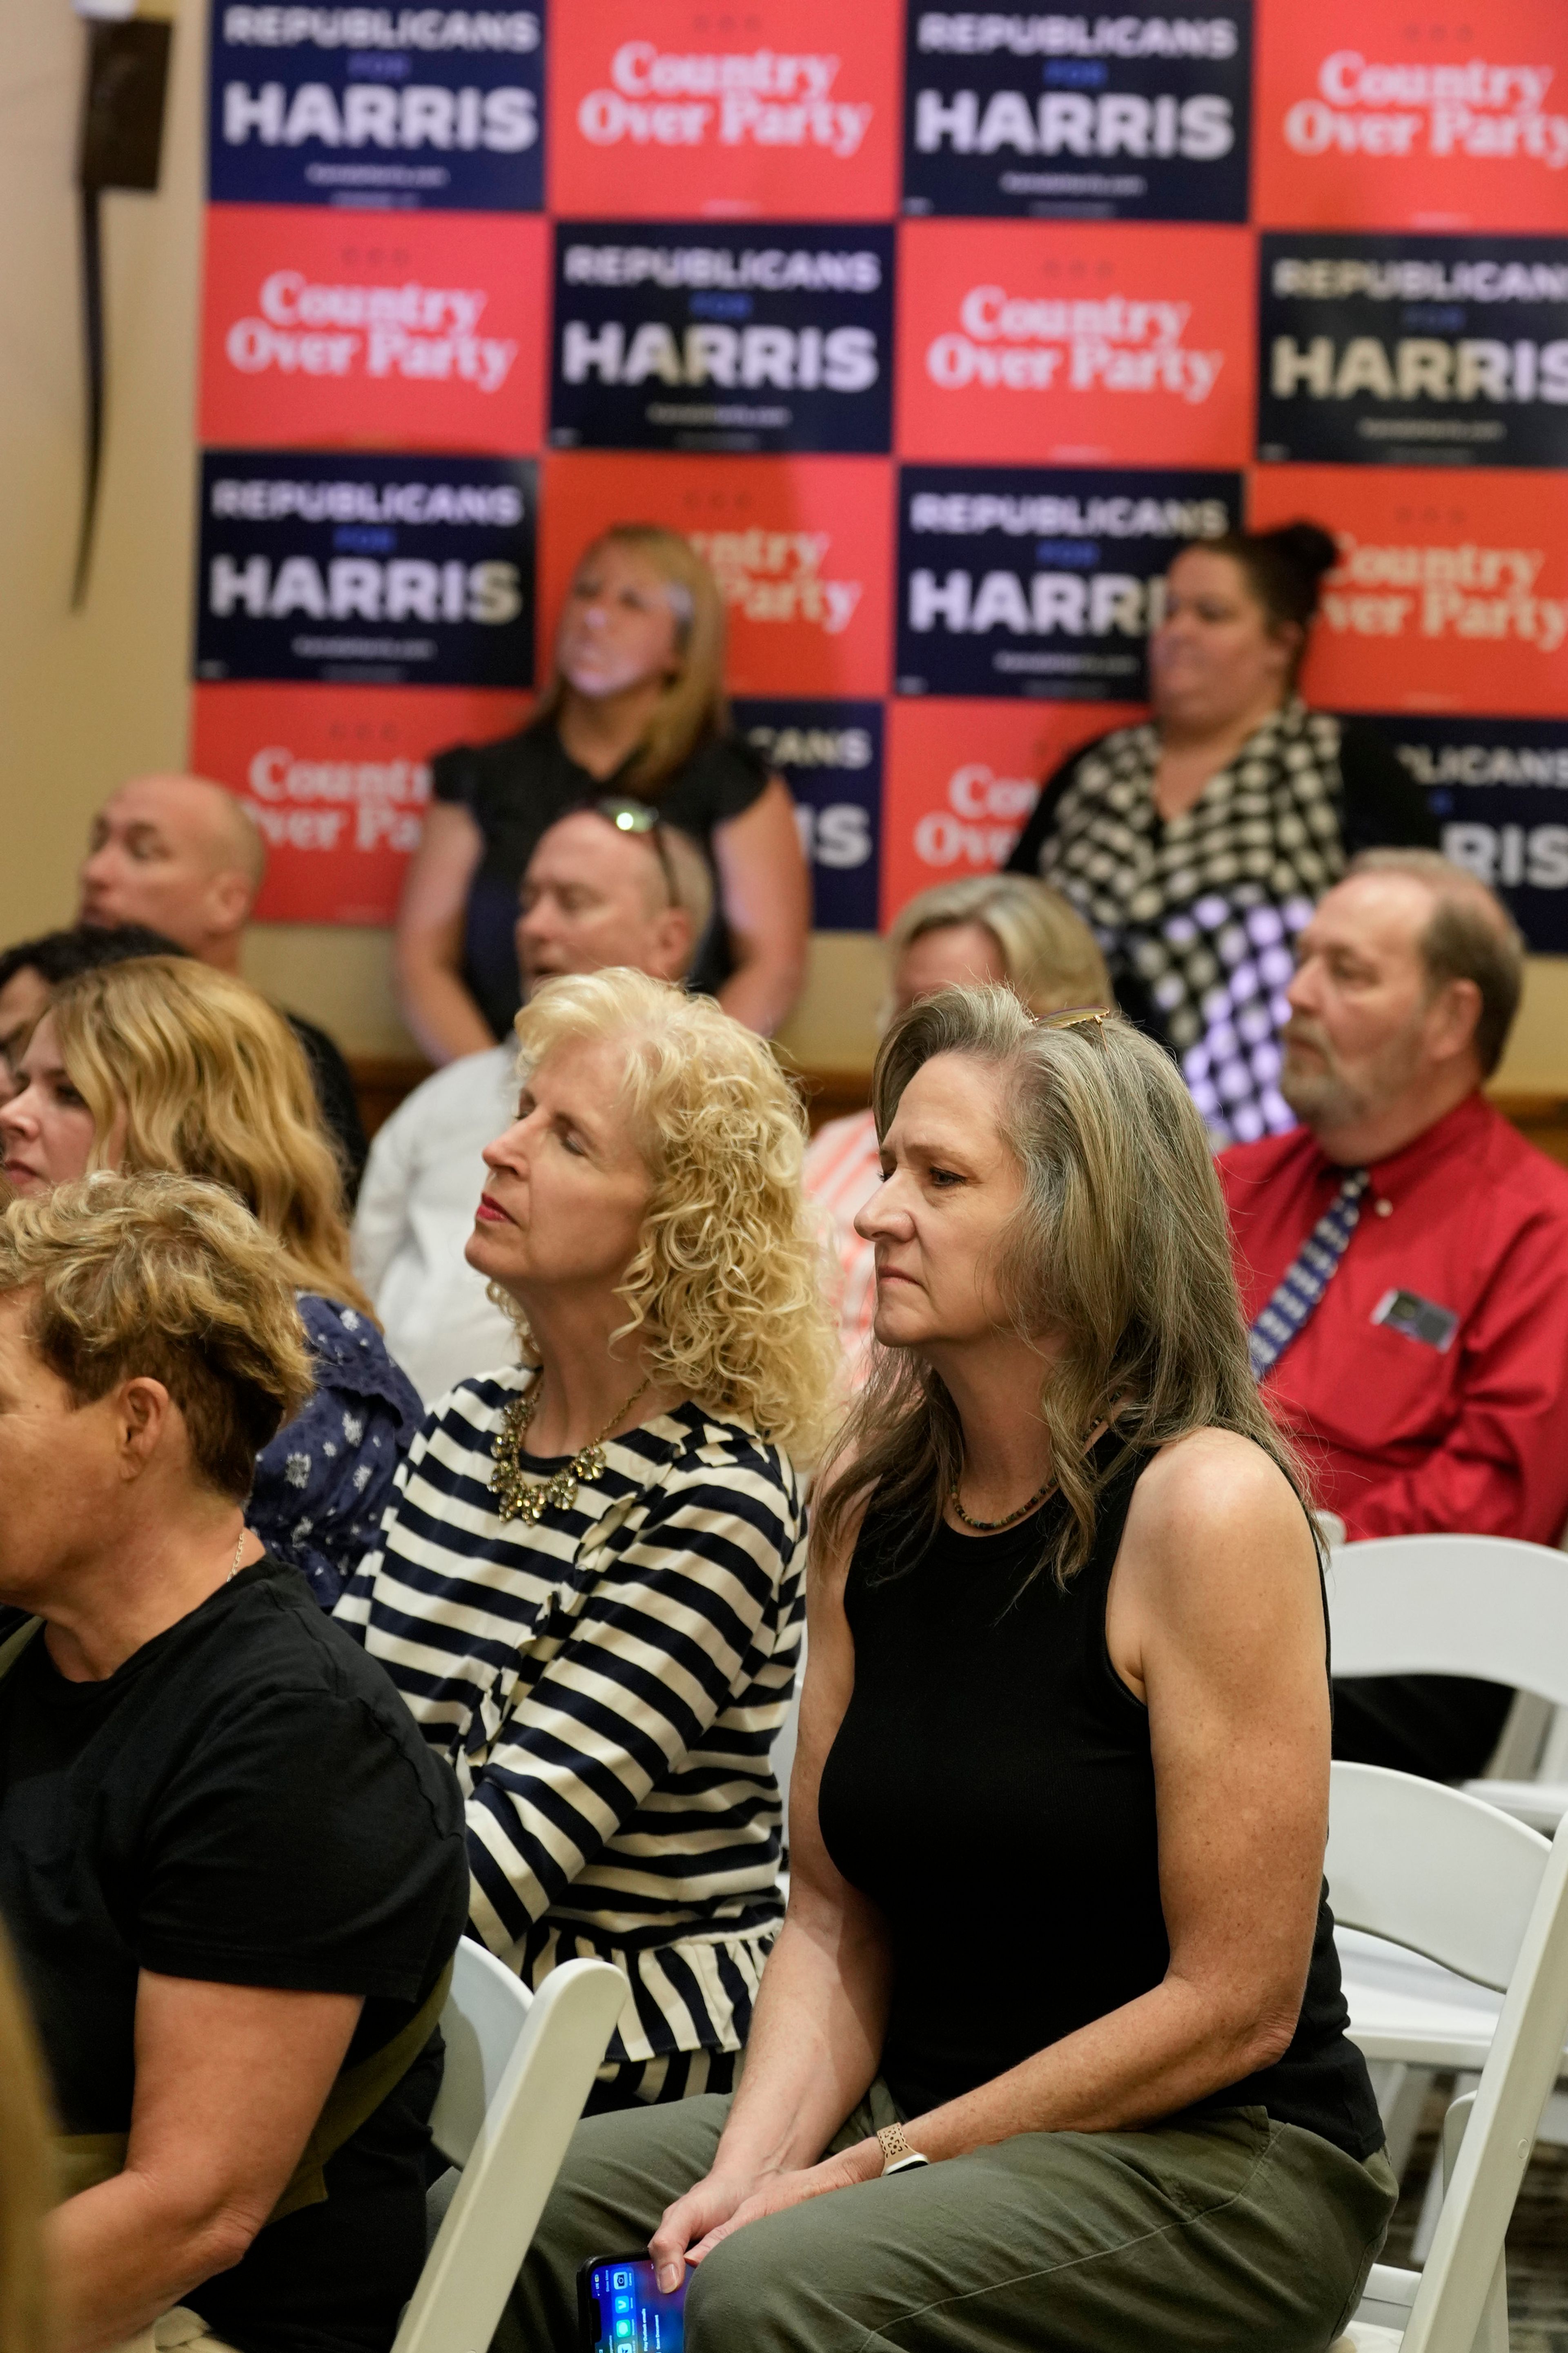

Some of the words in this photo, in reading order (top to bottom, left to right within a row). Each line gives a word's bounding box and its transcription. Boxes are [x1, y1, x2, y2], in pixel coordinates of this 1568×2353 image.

[225, 6, 539, 52] REPUBLICANS
[918, 13, 1237, 59] REPUBLICANS
[611, 42, 840, 100] Country
[1318, 50, 1552, 108] Country
[225, 83, 538, 152] HARRIS
[577, 89, 713, 145] Over
[720, 92, 871, 157] Party
[916, 90, 1233, 159] HARRIS
[1285, 99, 1423, 156] Over
[565, 246, 880, 292] REPUBLICANS
[261, 271, 486, 329] Country
[960, 285, 1190, 344] Country
[227, 317, 361, 375] Over
[367, 328, 515, 392] Party
[564, 322, 878, 392] HARRIS
[927, 332, 1063, 389] Over
[1069, 339, 1222, 403] Party
[213, 481, 523, 526] REPUBLICANS
[911, 493, 1224, 537] REPUBLICANS
[211, 555, 521, 624] HARRIS
[910, 569, 1167, 637] HARRI
[1324, 593, 1414, 636] ver
[1422, 588, 1568, 652] Party
[249, 746, 434, 803] Countr
[243, 797, 348, 851] ver
